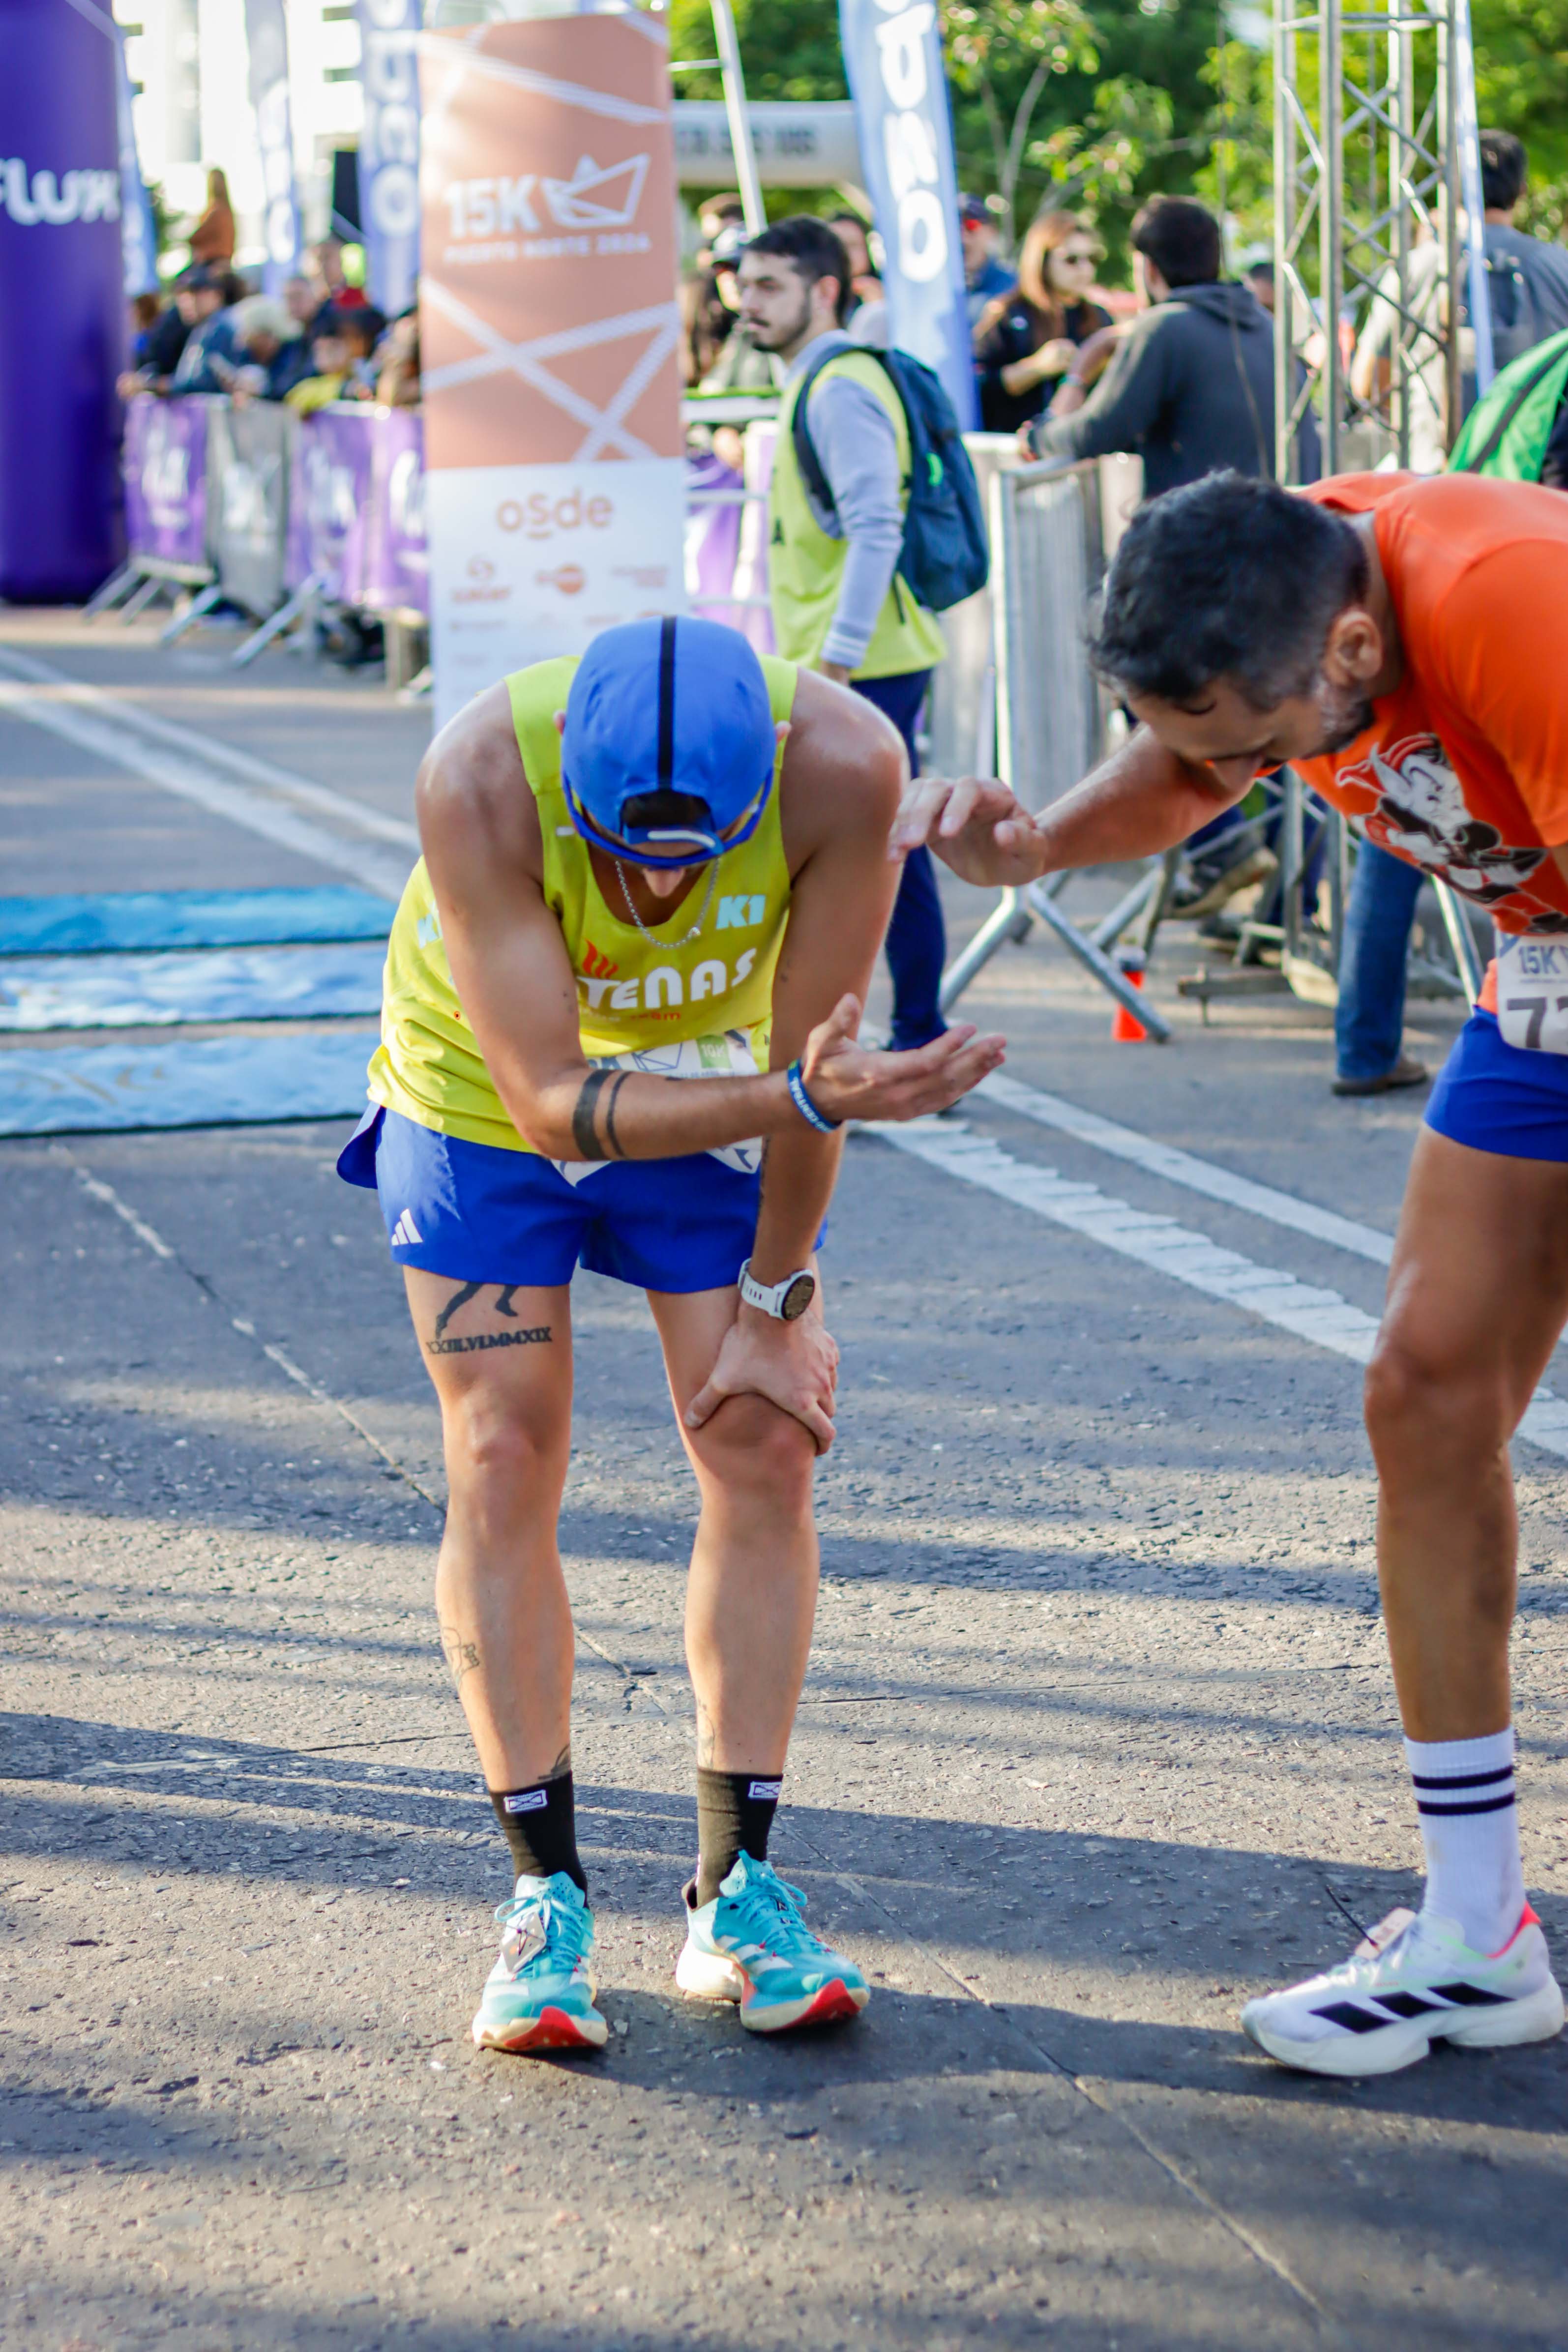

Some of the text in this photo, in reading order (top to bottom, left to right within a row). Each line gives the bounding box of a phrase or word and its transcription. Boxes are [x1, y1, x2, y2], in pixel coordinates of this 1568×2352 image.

[0, 156, 120, 226] lux
[444, 175, 541, 239] 15K
[497, 486, 613, 538] osde
[1518, 944, 1561, 974] 15K
